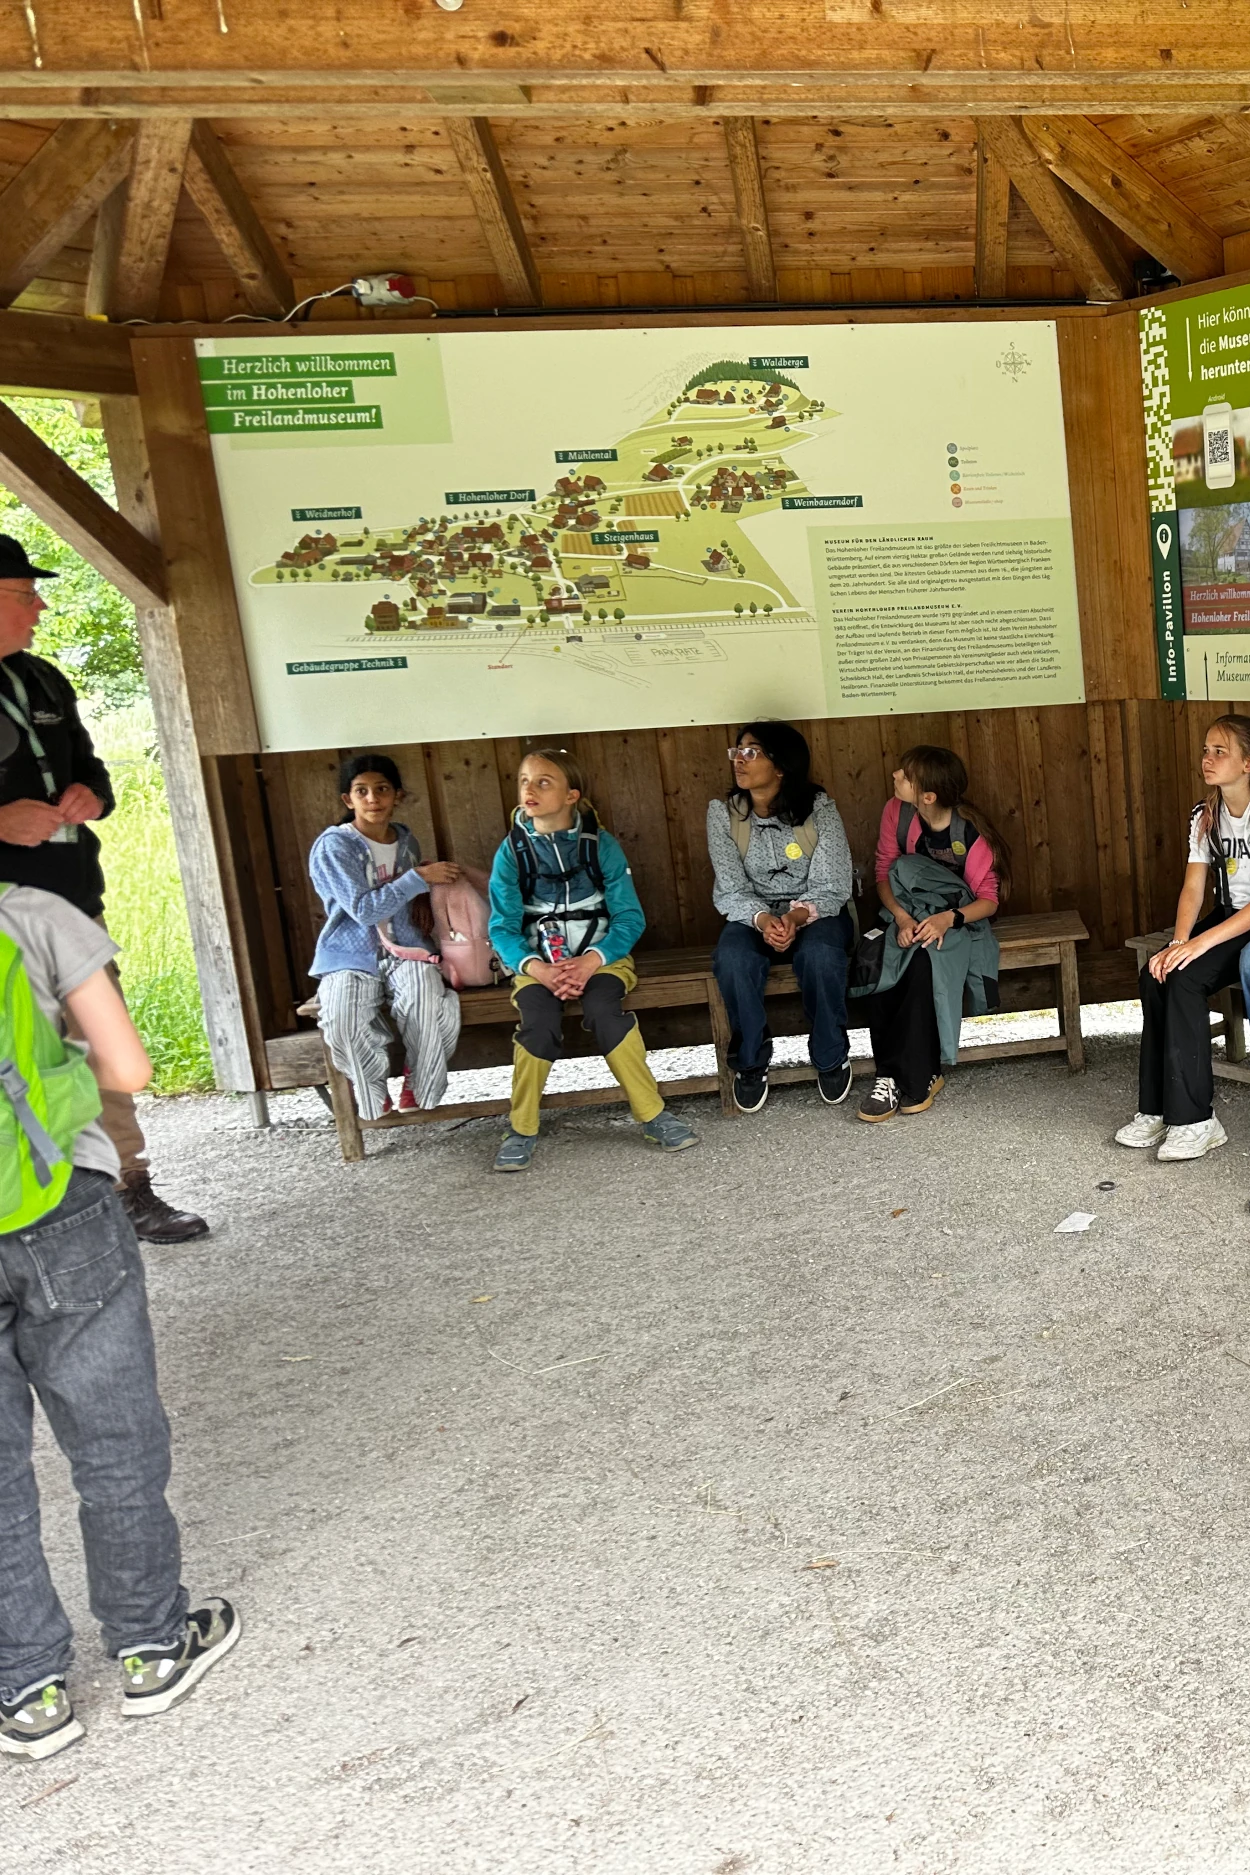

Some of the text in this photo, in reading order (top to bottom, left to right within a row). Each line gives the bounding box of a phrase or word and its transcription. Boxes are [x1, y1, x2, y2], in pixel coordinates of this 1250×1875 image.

[1198, 311, 1220, 329] Hier
[1200, 338, 1216, 355] die
[223, 356, 391, 374] Herzlich willkommen
[761, 358, 804, 369] Waldberge
[226, 382, 349, 401] im Hohenloher
[1207, 393, 1226, 403] Android
[233, 408, 377, 427] Freilandmuseum!
[567, 450, 613, 461] Mühlental
[458, 490, 530, 502] Hohenloher Dorf
[793, 497, 859, 508] Weinbauerndorf
[305, 508, 357, 519] Weidnerhof
[604, 532, 654, 543] Steigenhaus
[1190, 589, 1218, 601] Herzlich
[1191, 611, 1231, 624] Hohenloher
[1161, 570, 1177, 682] Info-Pavillon
[292, 659, 395, 674] Gebäudegruppe Technik
